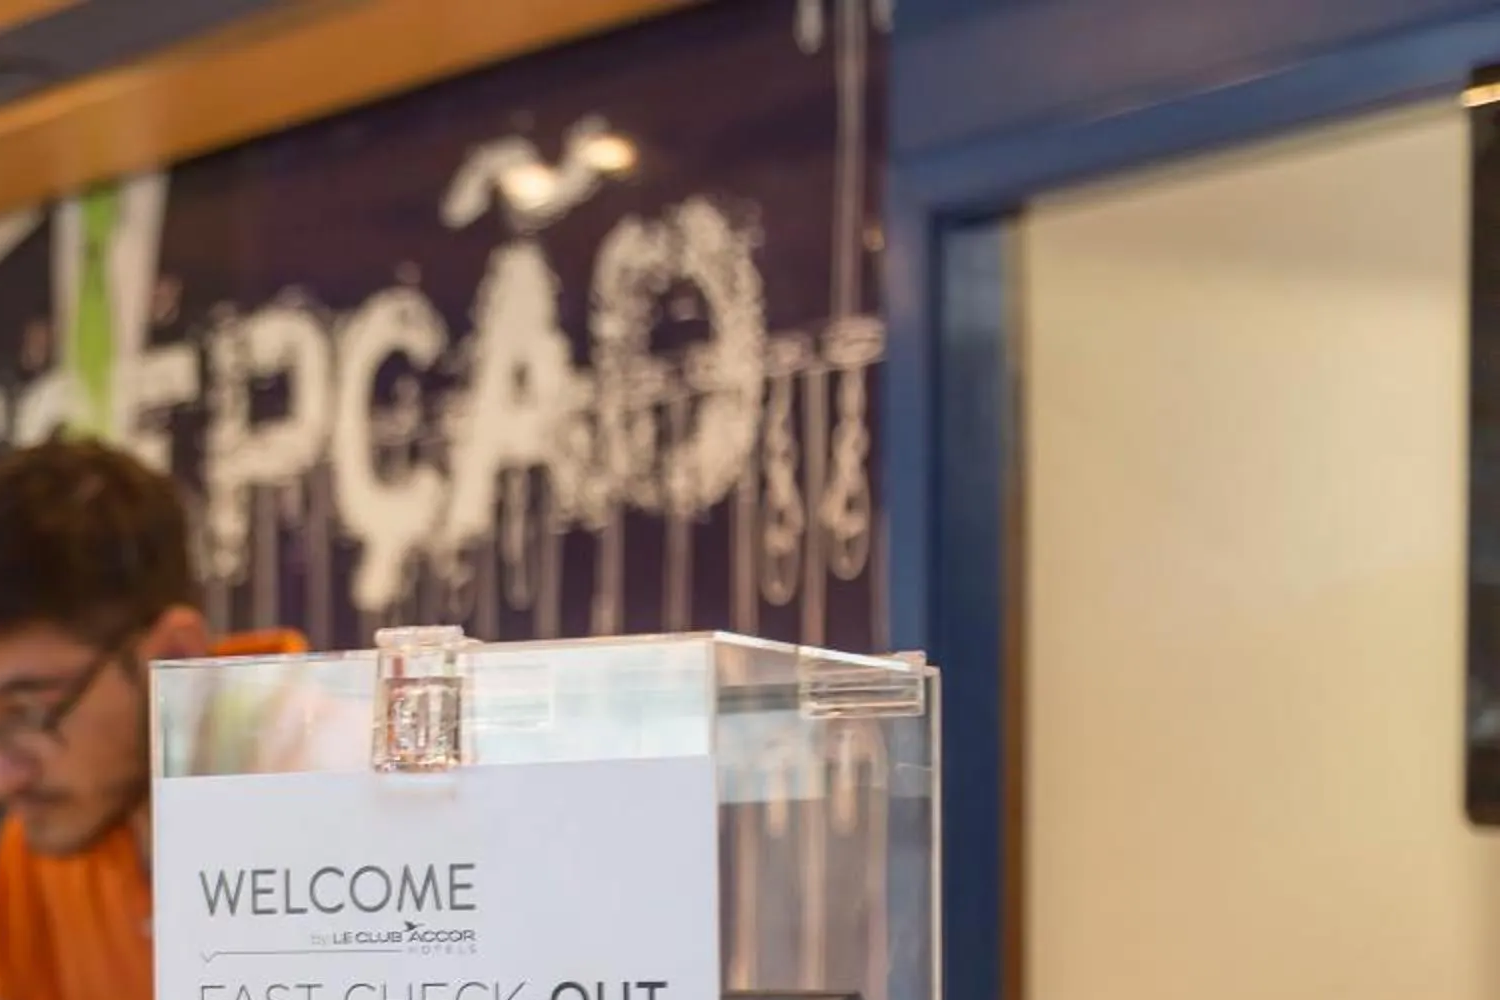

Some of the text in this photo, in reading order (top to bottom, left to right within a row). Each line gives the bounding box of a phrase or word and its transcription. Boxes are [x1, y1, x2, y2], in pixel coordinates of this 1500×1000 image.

[199, 863, 476, 916] WELCOME
[333, 931, 352, 945] LE
[355, 930, 402, 944] CLUB
[408, 929, 476, 943] ACCOR
